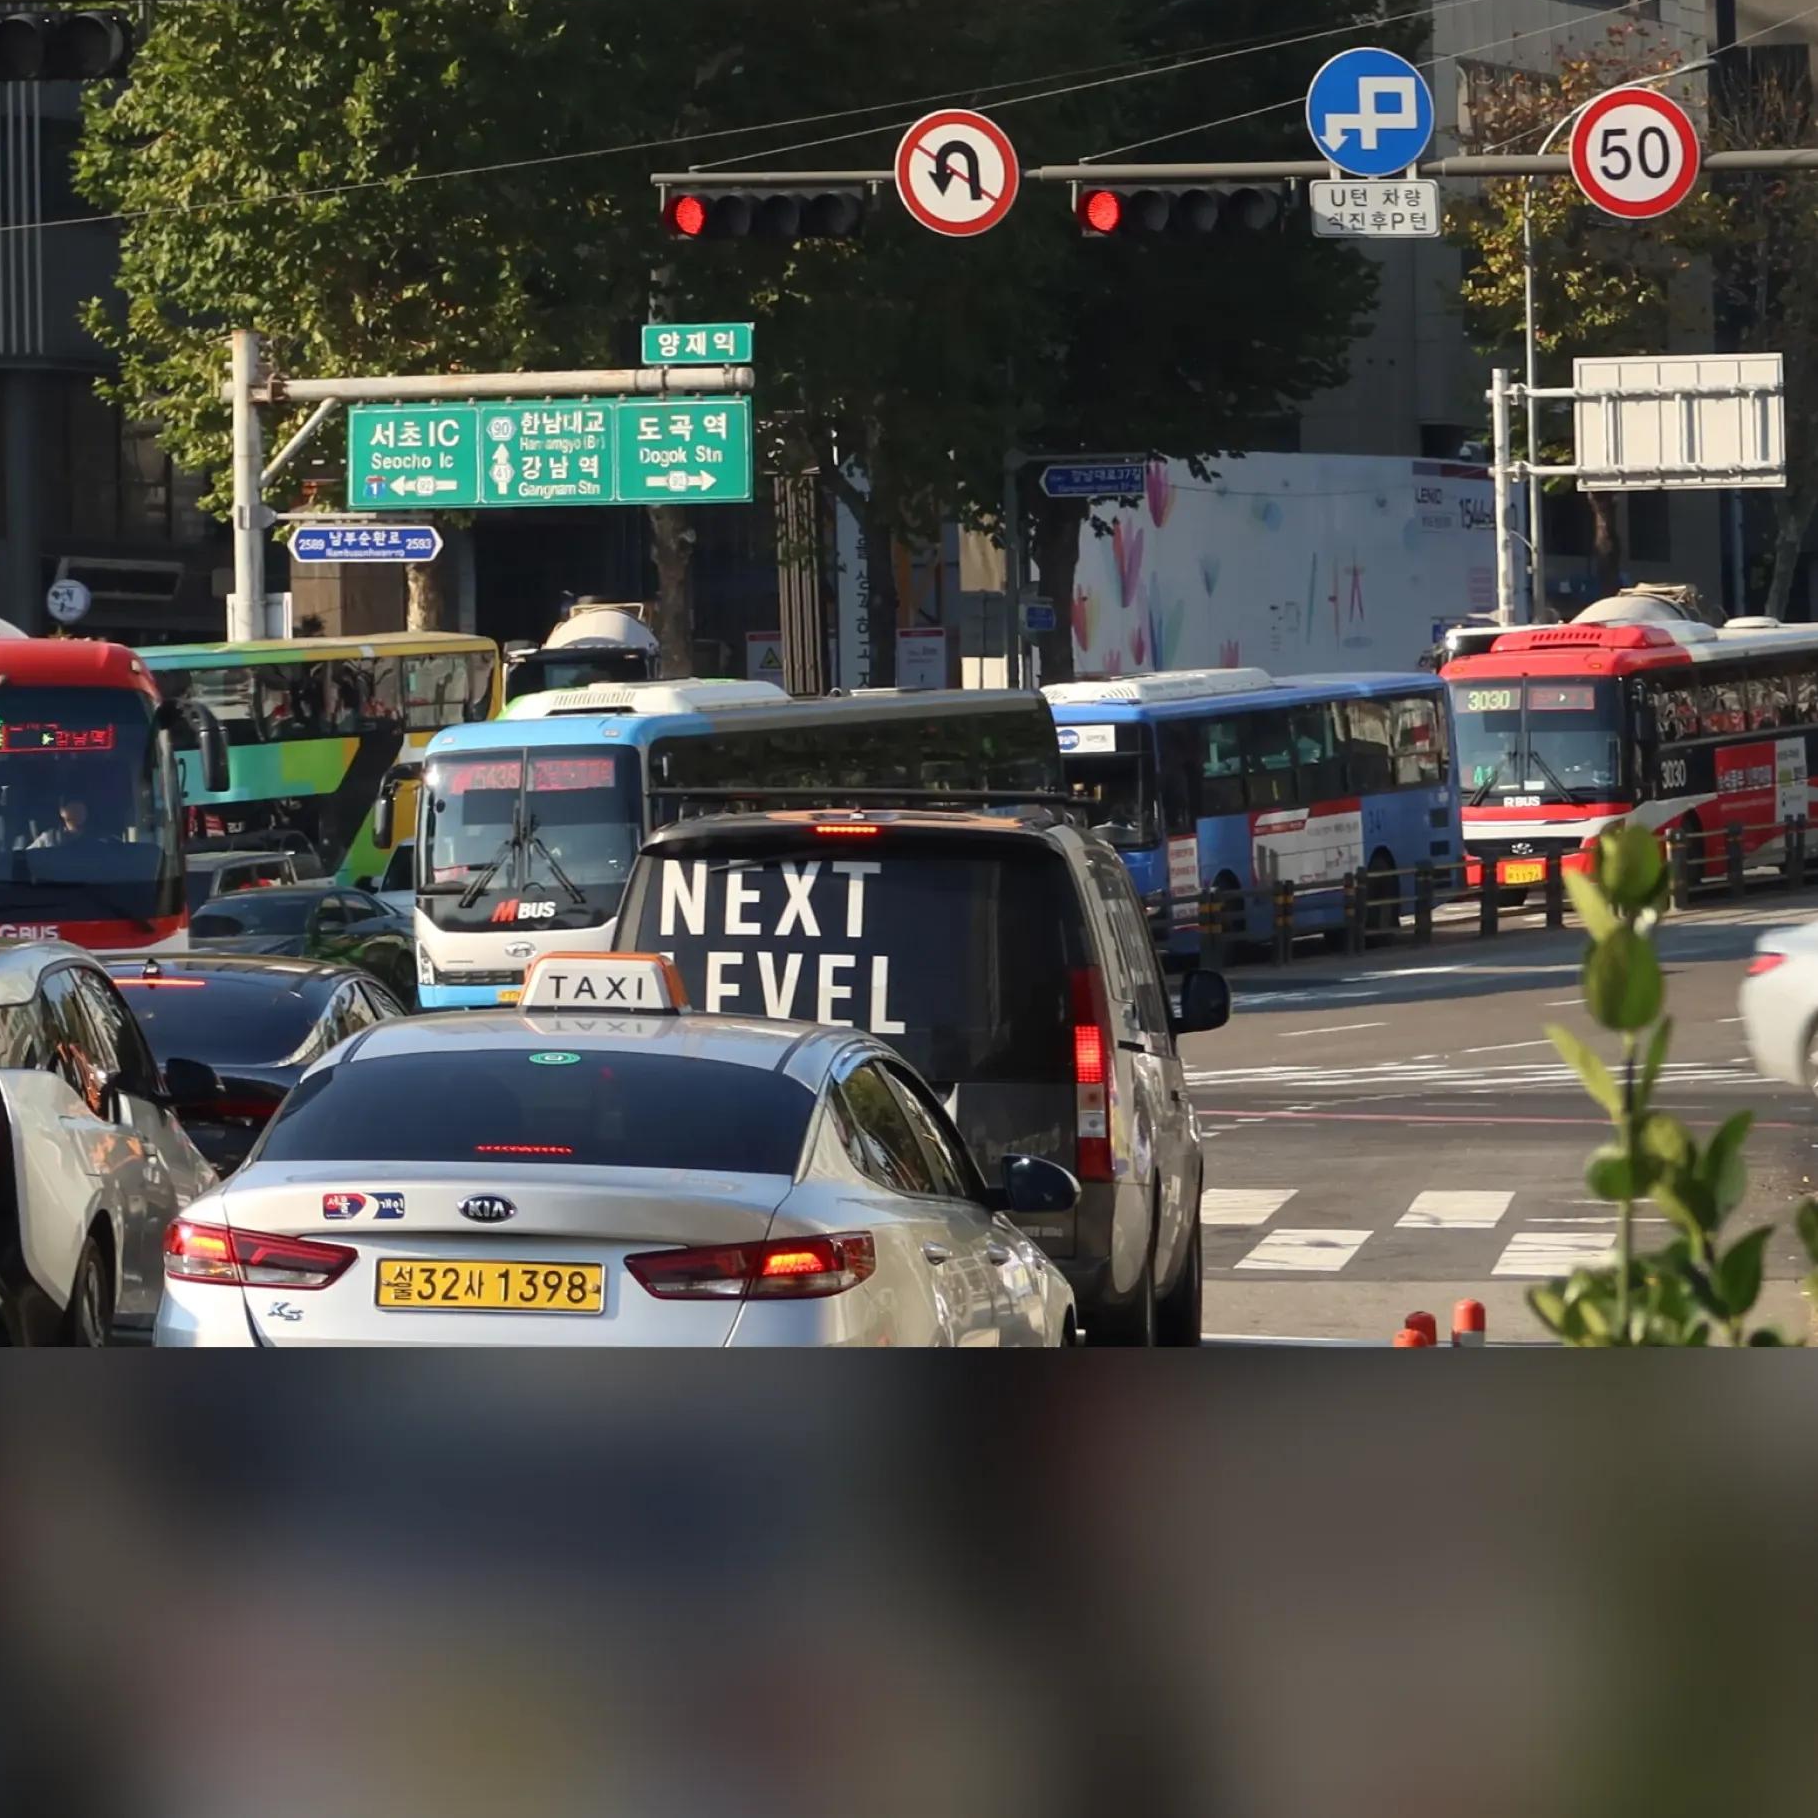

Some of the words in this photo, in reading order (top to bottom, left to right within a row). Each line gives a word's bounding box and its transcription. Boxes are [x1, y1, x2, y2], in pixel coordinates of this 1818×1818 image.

[1599, 125, 1672, 181] 50
[1330, 188, 1368, 207] U턴
[1382, 187, 1422, 207] 차량
[657, 330, 736, 358] 양재역
[492, 421, 511, 436] 90
[520, 410, 606, 435] 한남대교
[636, 412, 728, 442] 도곡역
[371, 451, 432, 470] Seocho
[521, 455, 600, 480] 강남역
[639, 445, 688, 468] Dogok
[694, 444, 724, 464] Stn
[518, 481, 577, 500] Gangnam
[577, 479, 601, 496] Stn
[328, 530, 403, 548] 남부순환로
[1467, 689, 1511, 712] 3030
[1660, 758, 1687, 790] 3030
[659, 859, 882, 938] NEXT
[548, 976, 643, 1001] TAXI
[660, 951, 907, 1036] EVEL
[327, 1194, 351, 1214] 서울
[468, 1200, 506, 1217] KIA
[392, 1266, 414, 1301] 서울
[417, 1267, 485, 1301] 32사
[497, 1269, 587, 1304] 1398
[268, 1300, 304, 1322] K5
